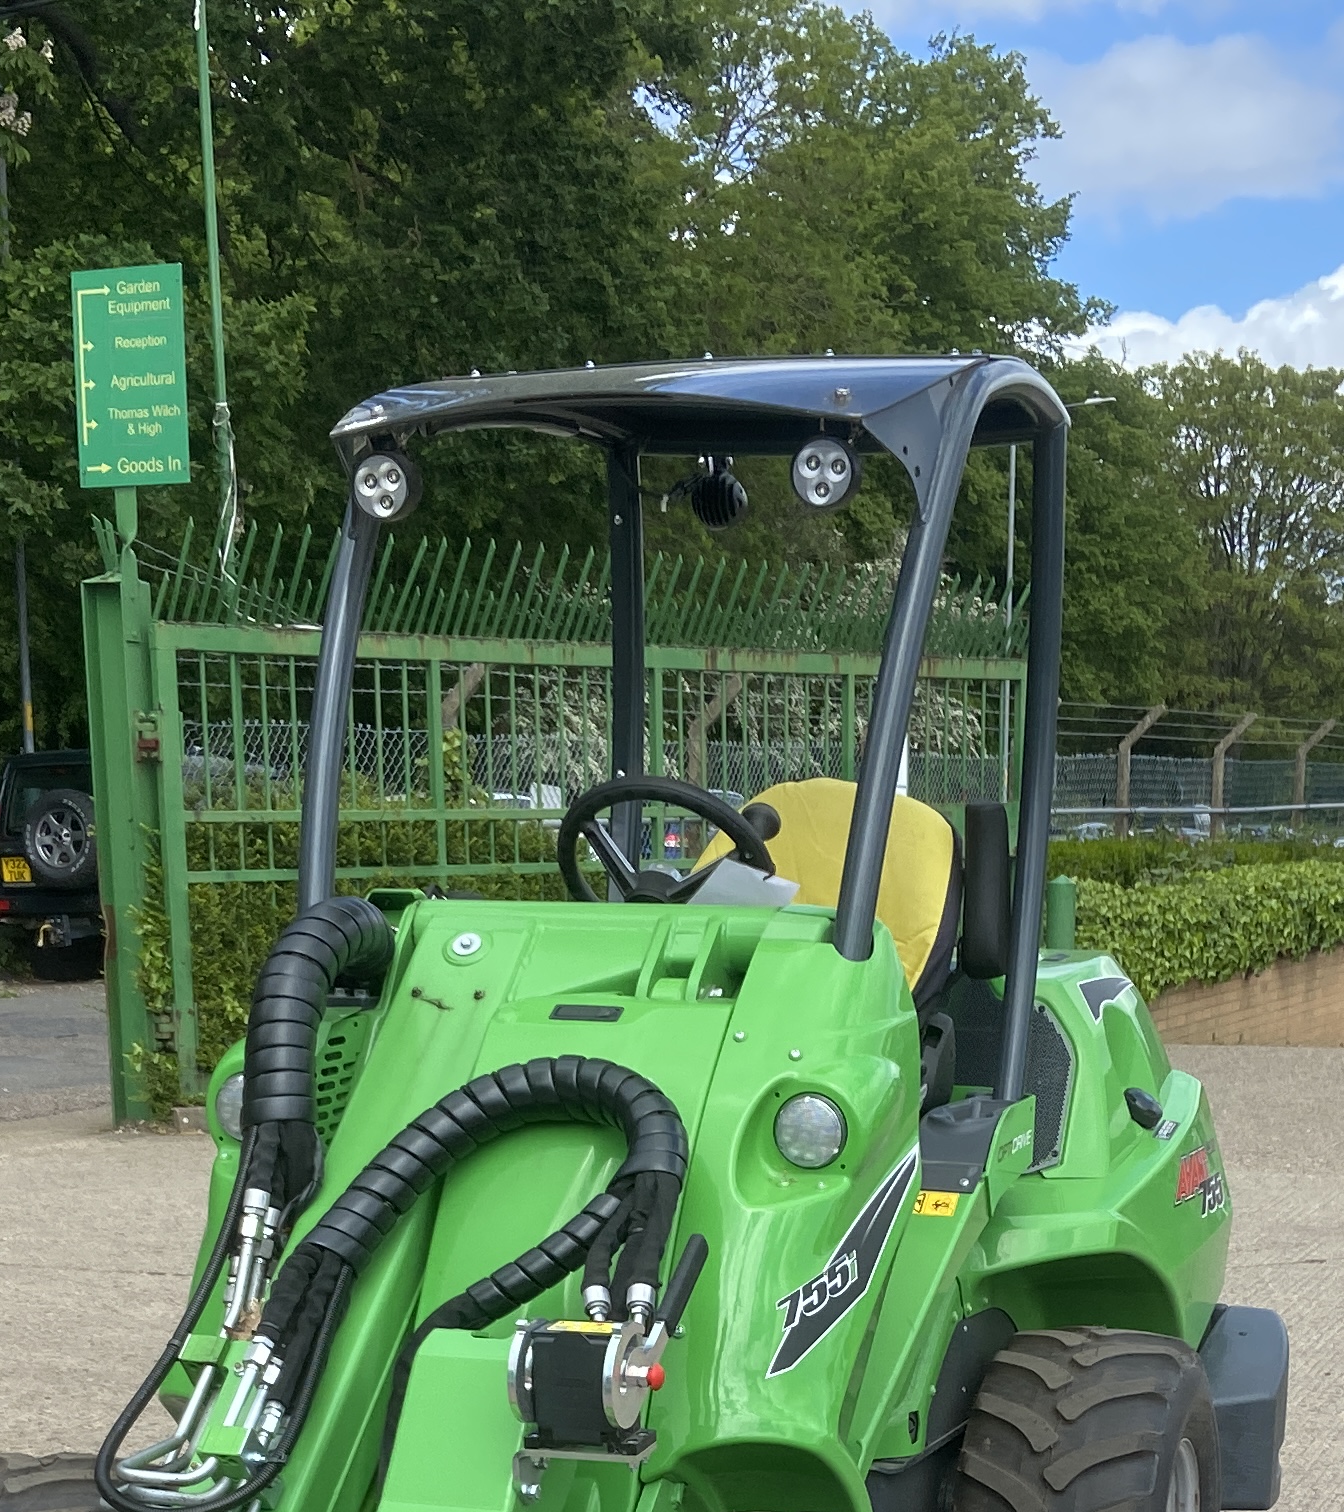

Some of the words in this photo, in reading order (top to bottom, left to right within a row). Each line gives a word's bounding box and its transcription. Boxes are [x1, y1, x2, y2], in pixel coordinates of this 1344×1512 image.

[116, 279, 160, 295] Garden
[108, 297, 170, 316] Equipment
[115, 335, 167, 349] Reception
[111, 371, 176, 391] Agricultural
[107, 407, 149, 419] Thomas
[127, 423, 135, 435] &
[138, 422, 162, 437] High
[117, 456, 164, 474] Goods
[168, 455, 181, 472] In
[775, 1249, 859, 1333] 755i
